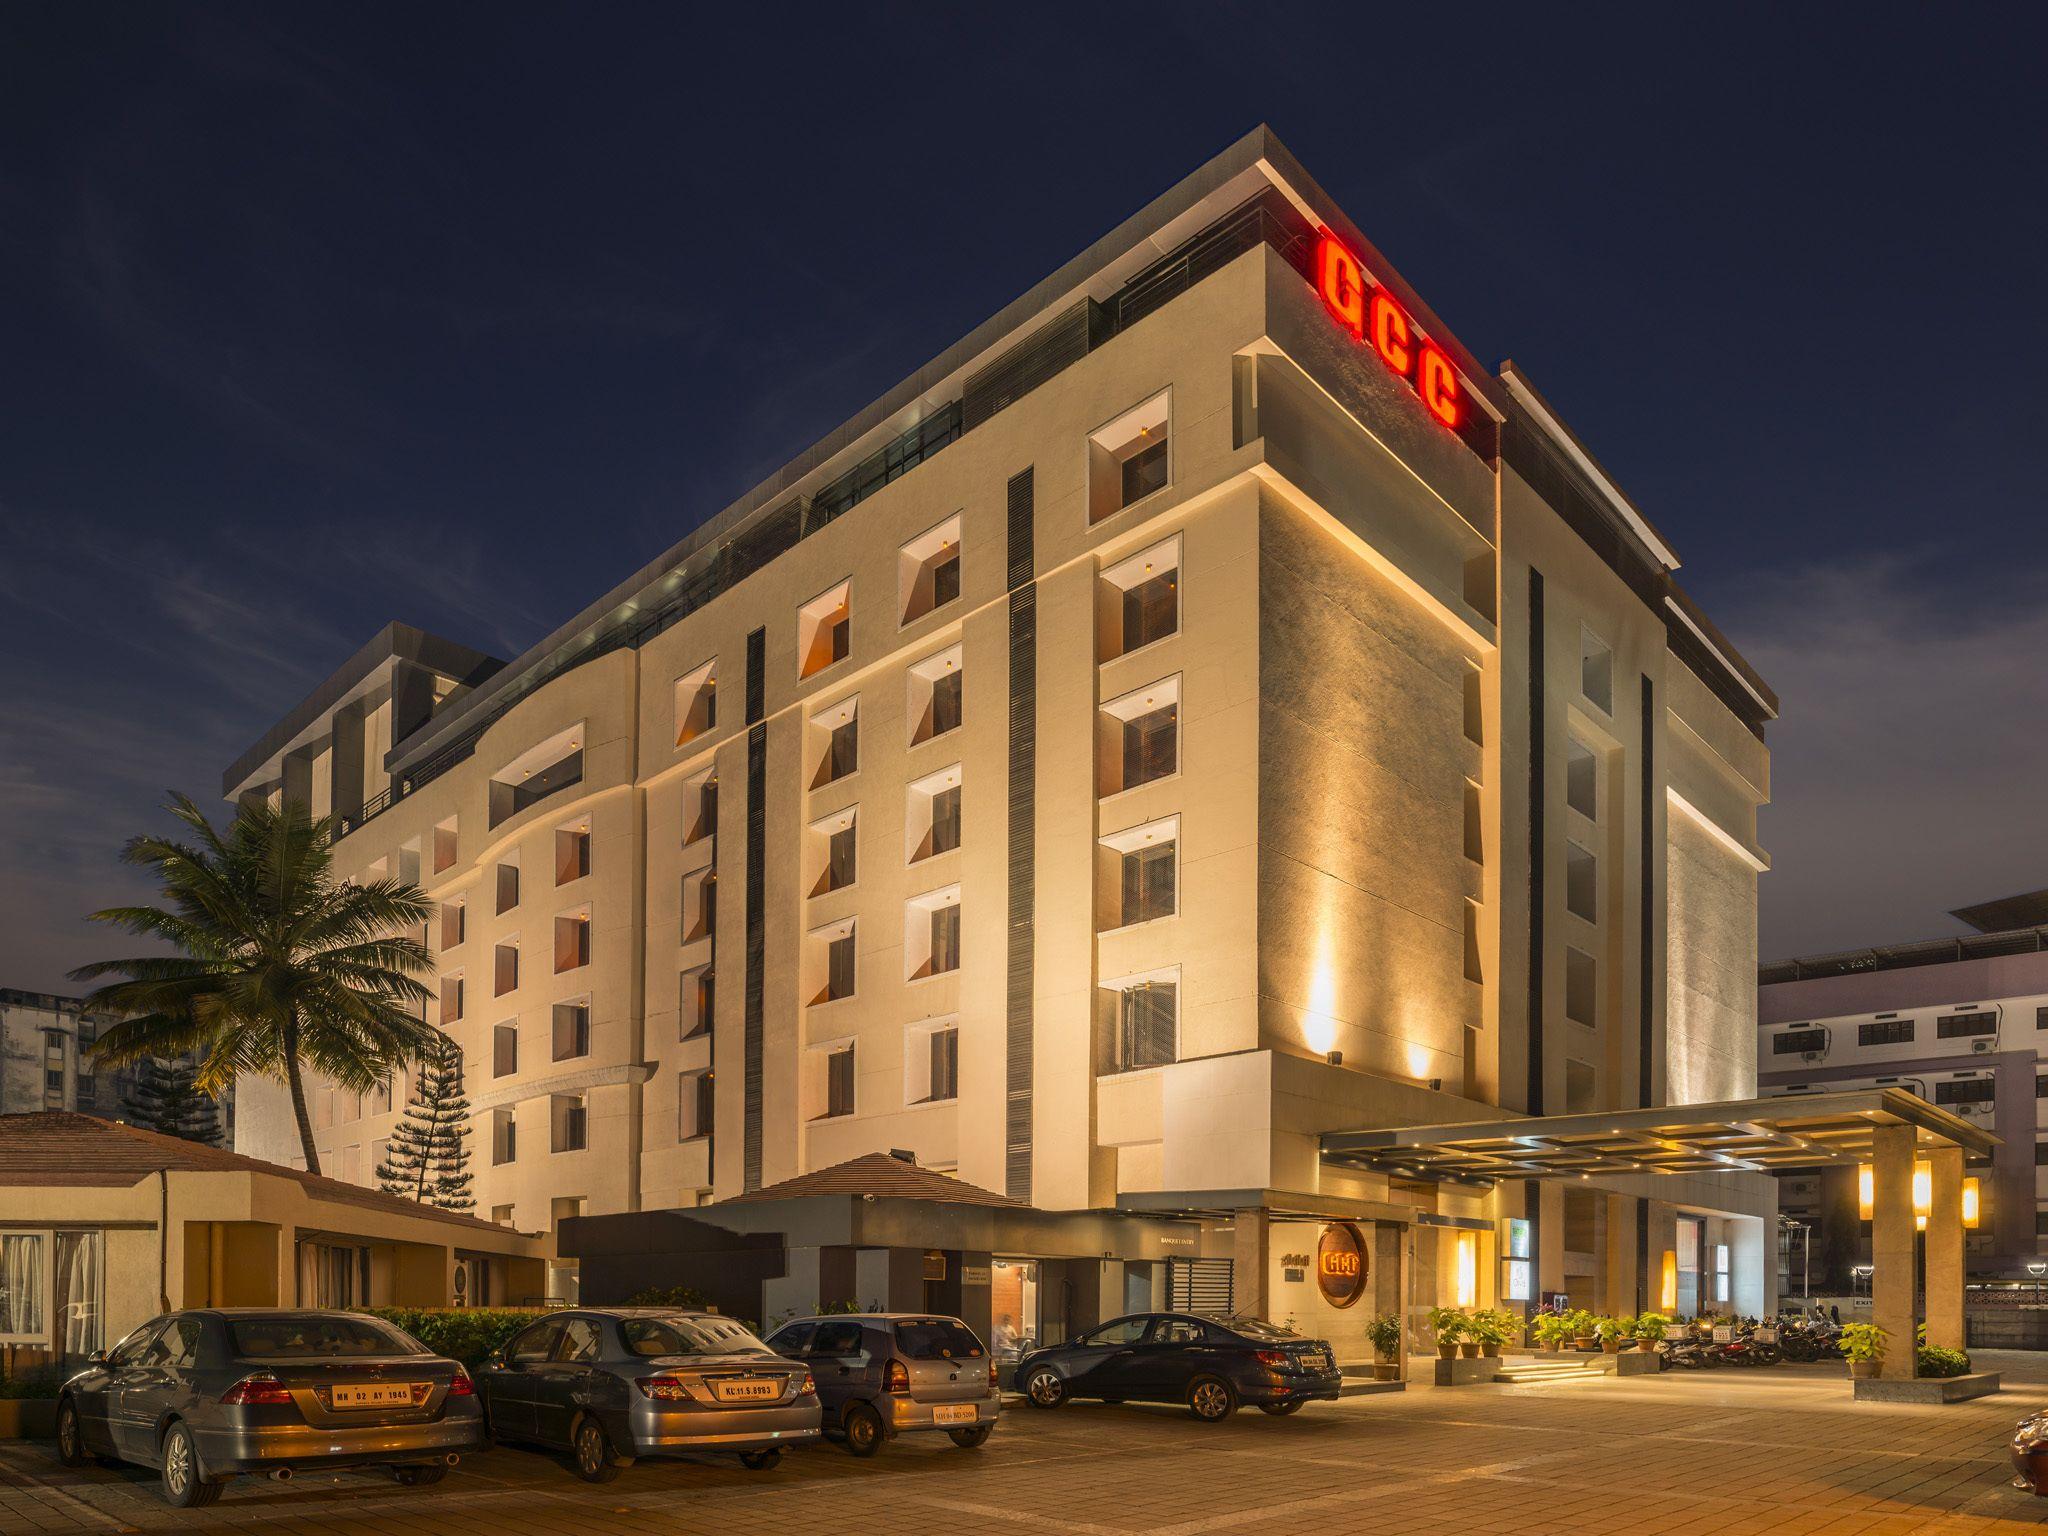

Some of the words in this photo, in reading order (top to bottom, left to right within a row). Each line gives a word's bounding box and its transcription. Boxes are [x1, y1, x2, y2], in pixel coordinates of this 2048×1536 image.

[1317, 238, 1458, 428] GCC
[356, 1392, 367, 1400] 02
[373, 1391, 383, 1400] AY
[389, 1390, 407, 1399] 1945
